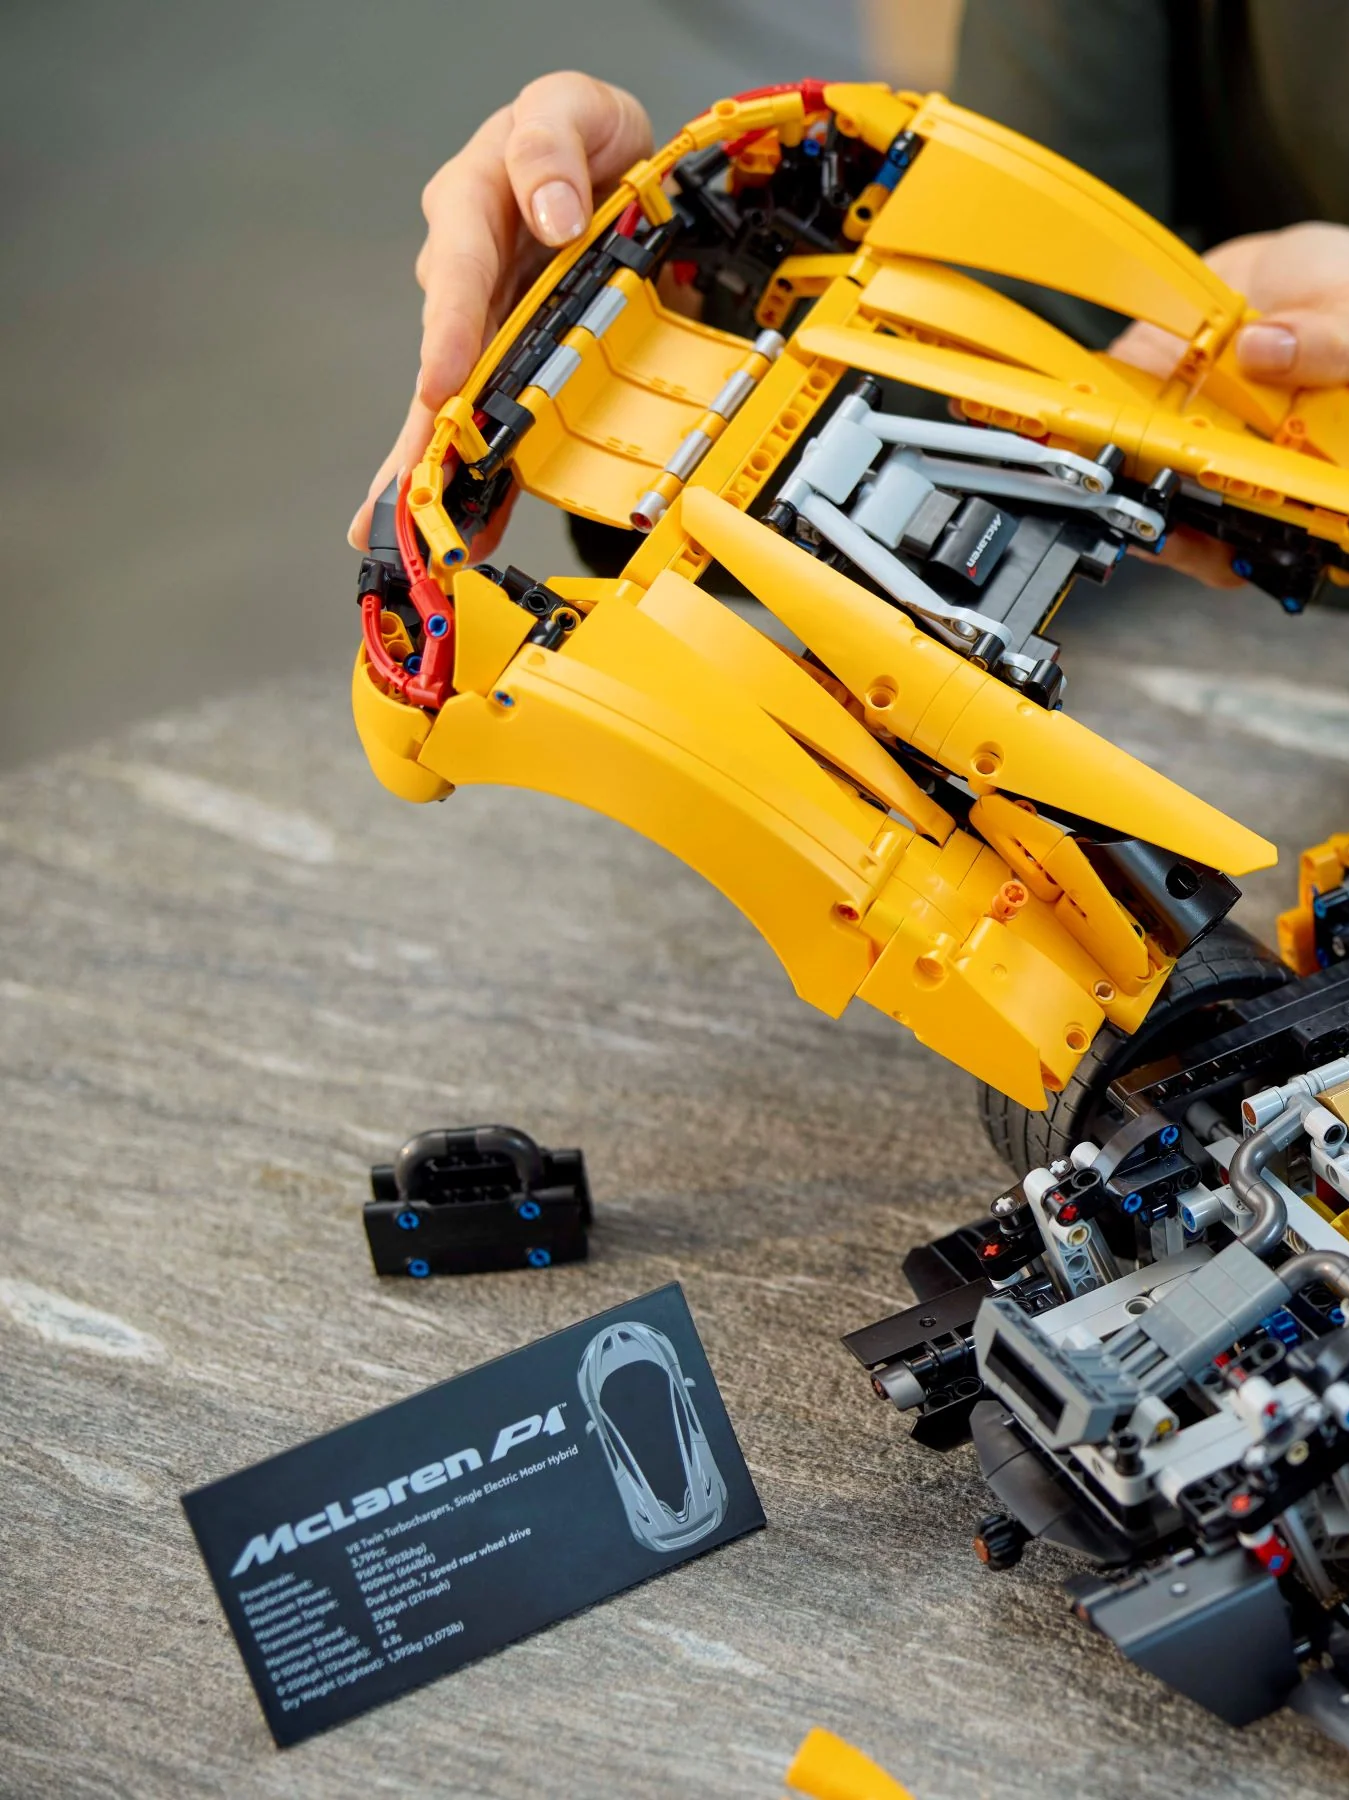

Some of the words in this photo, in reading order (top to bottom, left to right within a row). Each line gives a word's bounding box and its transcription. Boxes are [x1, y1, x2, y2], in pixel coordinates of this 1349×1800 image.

[966, 513, 1002, 568] McLaren
[231, 1447, 484, 1577] McLaren
[359, 1533, 385, 1549] Twin
[383, 1503, 455, 1538] Turbochargers,
[453, 1488, 483, 1508] Single
[483, 1472, 519, 1495] Electric
[518, 1460, 546, 1479] Motor
[547, 1443, 579, 1466] Hybrid
[364, 1589, 389, 1608] Dual
[388, 1577, 422, 1598] clutch,
[420, 1571, 427, 1583] 7
[429, 1558, 458, 1580] speed
[458, 1551, 477, 1566] rear
[478, 1535, 507, 1557] wheel
[507, 1527, 532, 1544] drive
[407, 1578, 451, 1607] (217mph)
[375, 1619, 398, 1635] 2.8s
[382, 1633, 403, 1649] 6.8s
